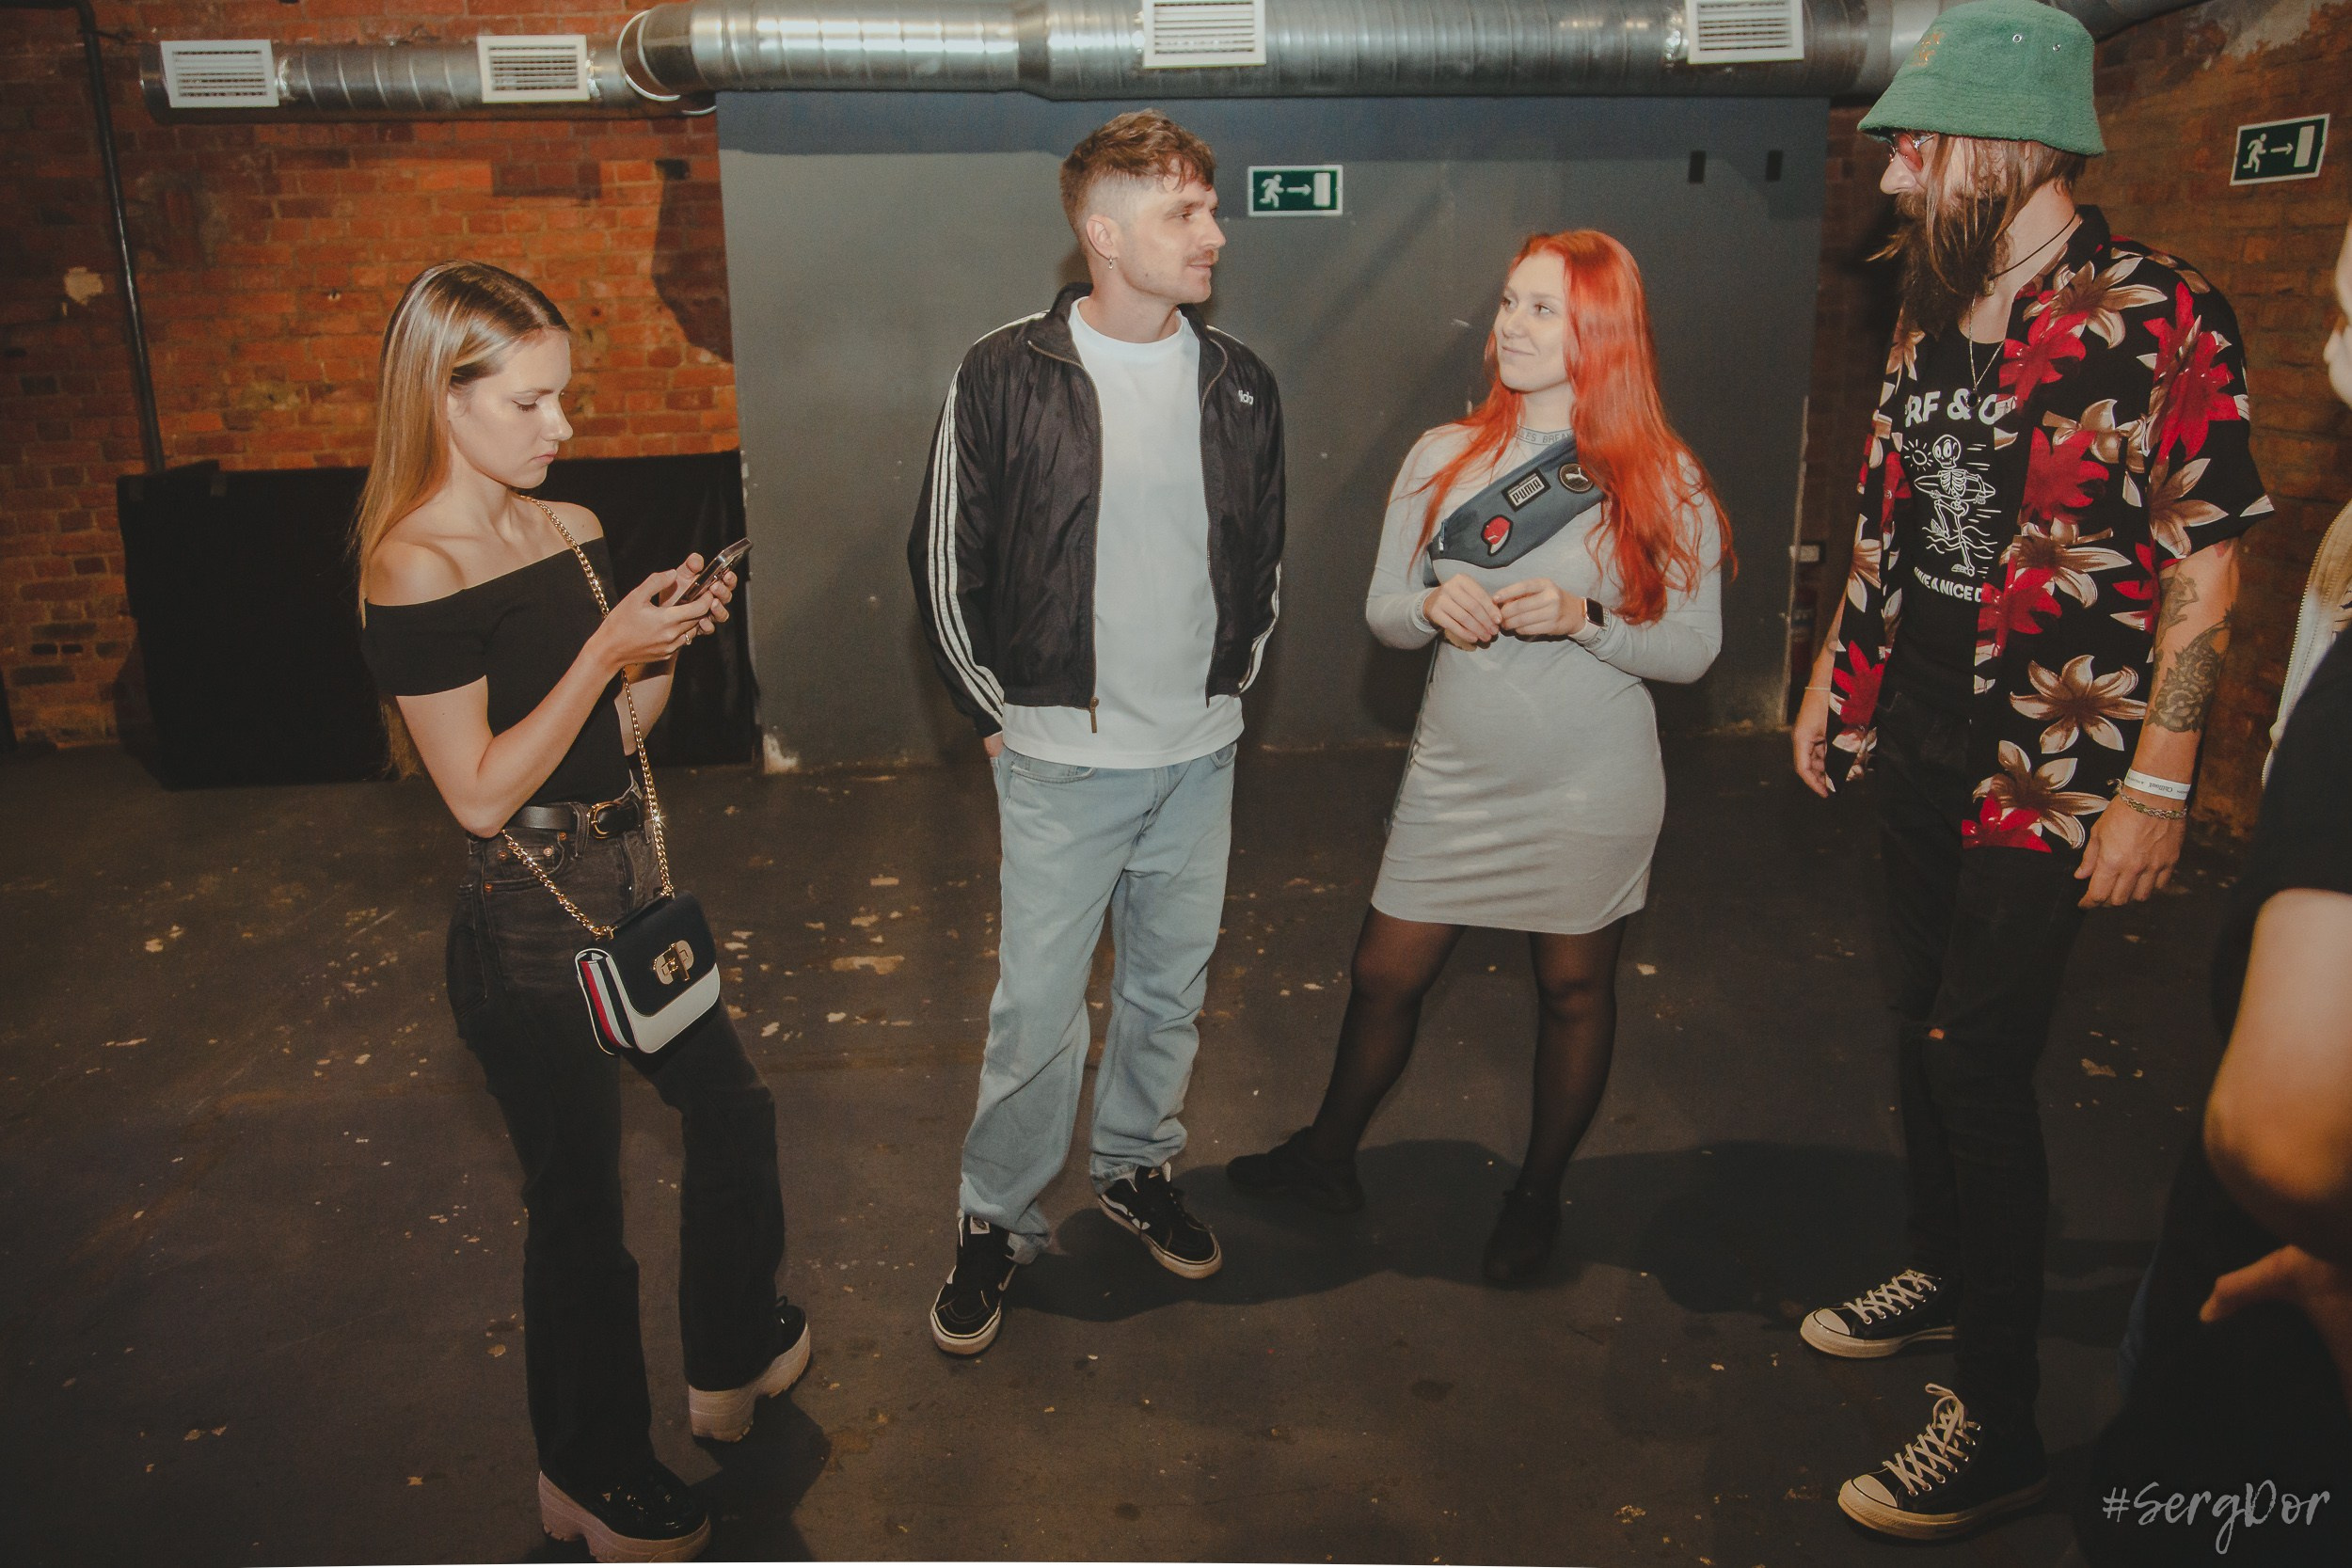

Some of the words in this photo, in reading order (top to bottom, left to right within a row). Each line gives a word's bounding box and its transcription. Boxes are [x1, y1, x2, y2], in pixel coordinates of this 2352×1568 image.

[1905, 390, 1941, 428] RF
[1947, 388, 1972, 420] &
[1511, 479, 1543, 504] PUMA
[1931, 577, 1940, 593] A
[1940, 578, 1974, 602] NICE
[1974, 587, 1982, 603] D
